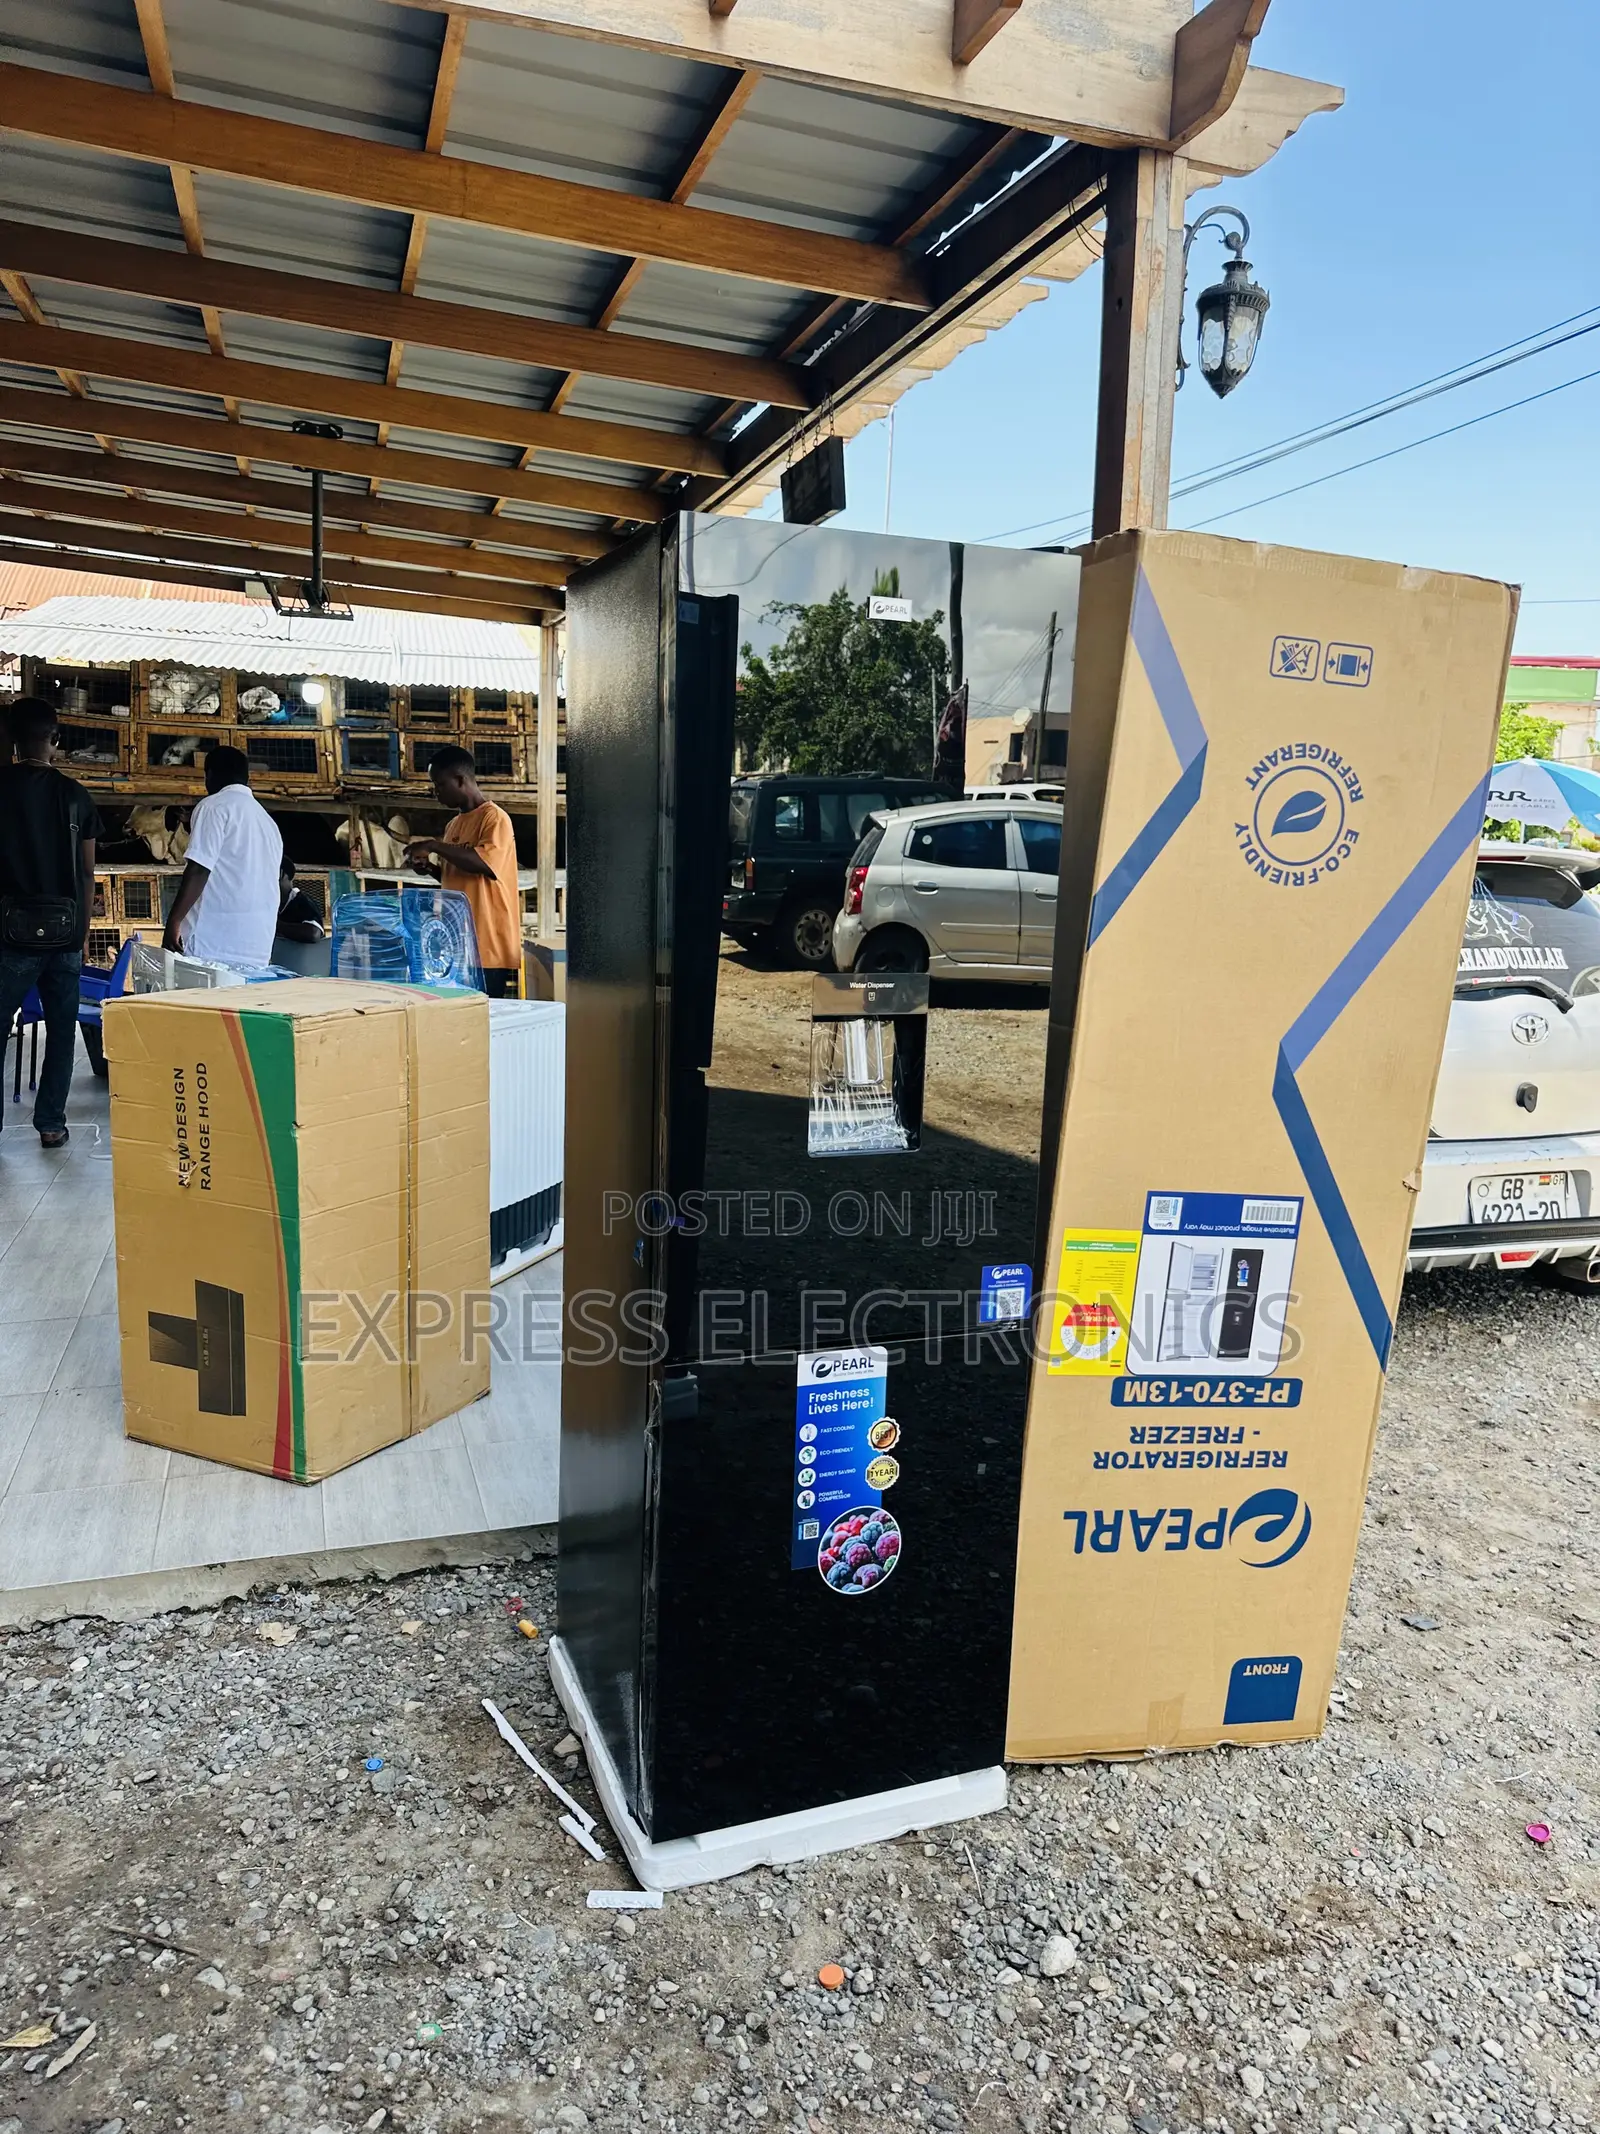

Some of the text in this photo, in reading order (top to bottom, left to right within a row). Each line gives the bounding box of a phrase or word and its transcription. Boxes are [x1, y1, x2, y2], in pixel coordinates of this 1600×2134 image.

[885, 605, 907, 614] PEARL
[1245, 743, 1364, 803] REFRIGERANT
[1234, 822, 1360, 887] ECO-FRIENDLY
[867, 982, 895, 990] Dispenser
[173, 1068, 191, 1188] NEW DESIGN
[196, 1062, 211, 1190] RANGE HOOD
[1501, 1174, 1565, 1200] GB GH
[1002, 1268, 1024, 1276] PEARL
[833, 1357, 874, 1372] PEARL
[808, 1388, 870, 1403] Freshness
[1123, 1381, 1290, 1403] PF-370-13M
[808, 1397, 874, 1415] Lives Here!
[1129, 1426, 1245, 1444] FREEZER
[819, 1447, 854, 1456] ECO-FRIENDLY
[1093, 1451, 1288, 1469] REFRIGERATOR
[874, 1467, 895, 1476] YEAR
[1063, 1508, 1228, 1554] PEARL
[1243, 1663, 1289, 1676] FRONT
